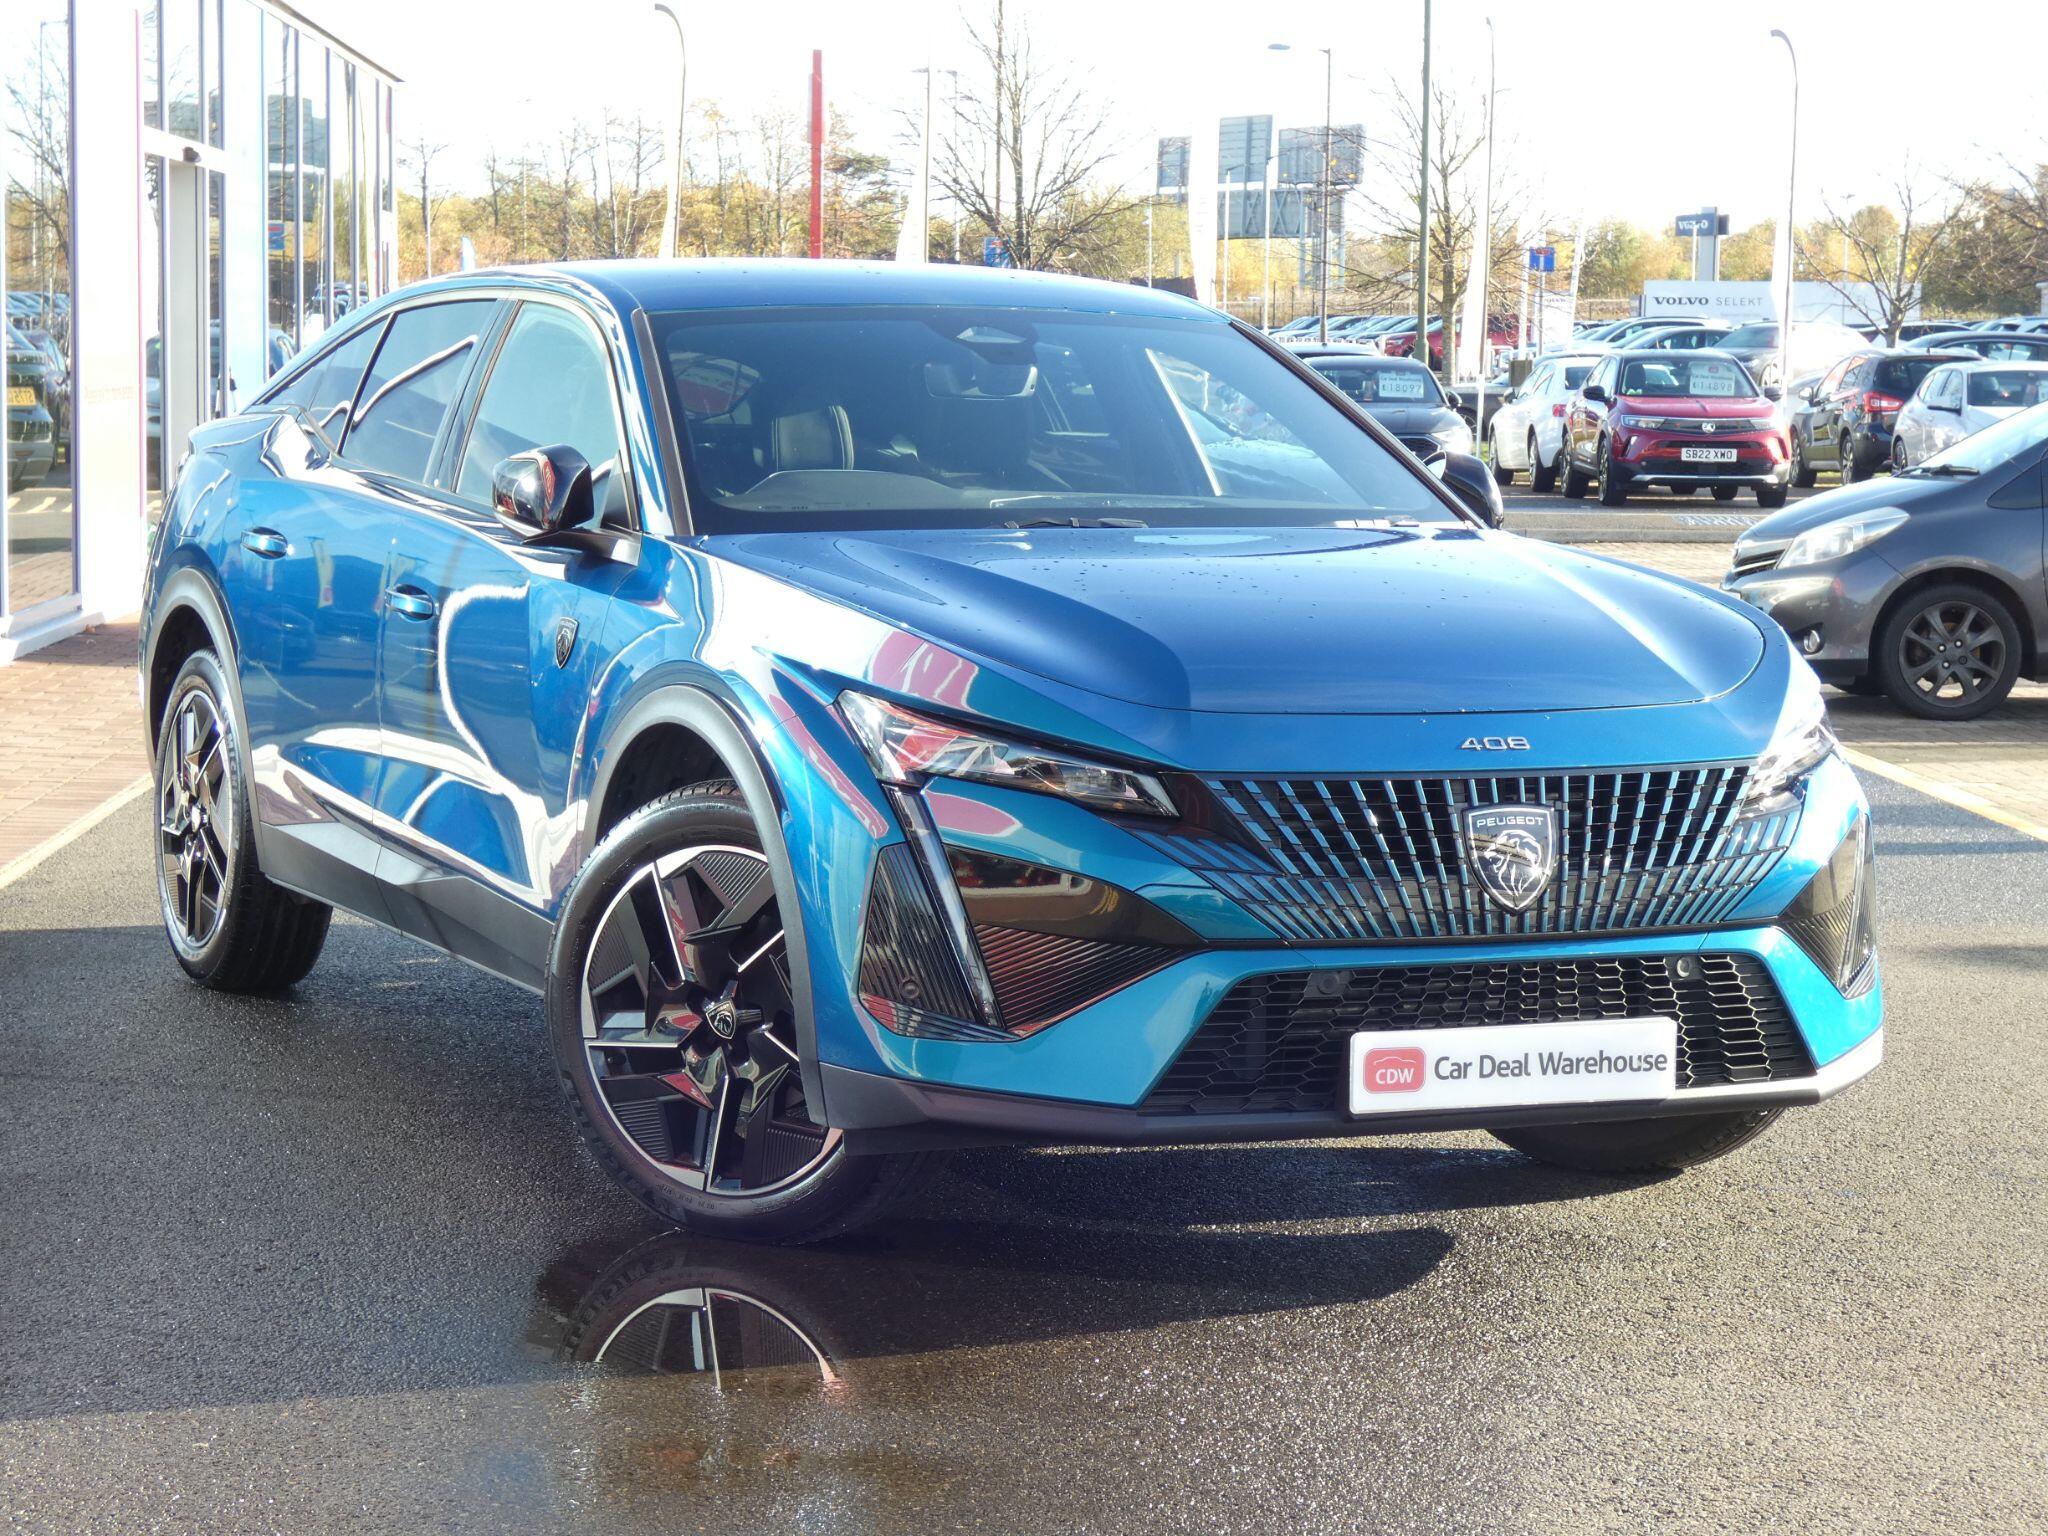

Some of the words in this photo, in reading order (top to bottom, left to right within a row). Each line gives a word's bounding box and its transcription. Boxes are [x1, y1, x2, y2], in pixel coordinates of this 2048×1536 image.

[1653, 296, 1709, 306] VOLVO
[1715, 297, 1763, 306] SELEKT
[1685, 450, 1711, 459] SB22
[1713, 450, 1733, 460] XWO
[1461, 736, 1531, 751] 408
[1476, 816, 1544, 828] PEUGEOT
[1434, 1056, 1472, 1080] Car
[1479, 1053, 1531, 1079] Deal
[1538, 1050, 1669, 1076] Warehouse
[1375, 1067, 1415, 1085] CDW
